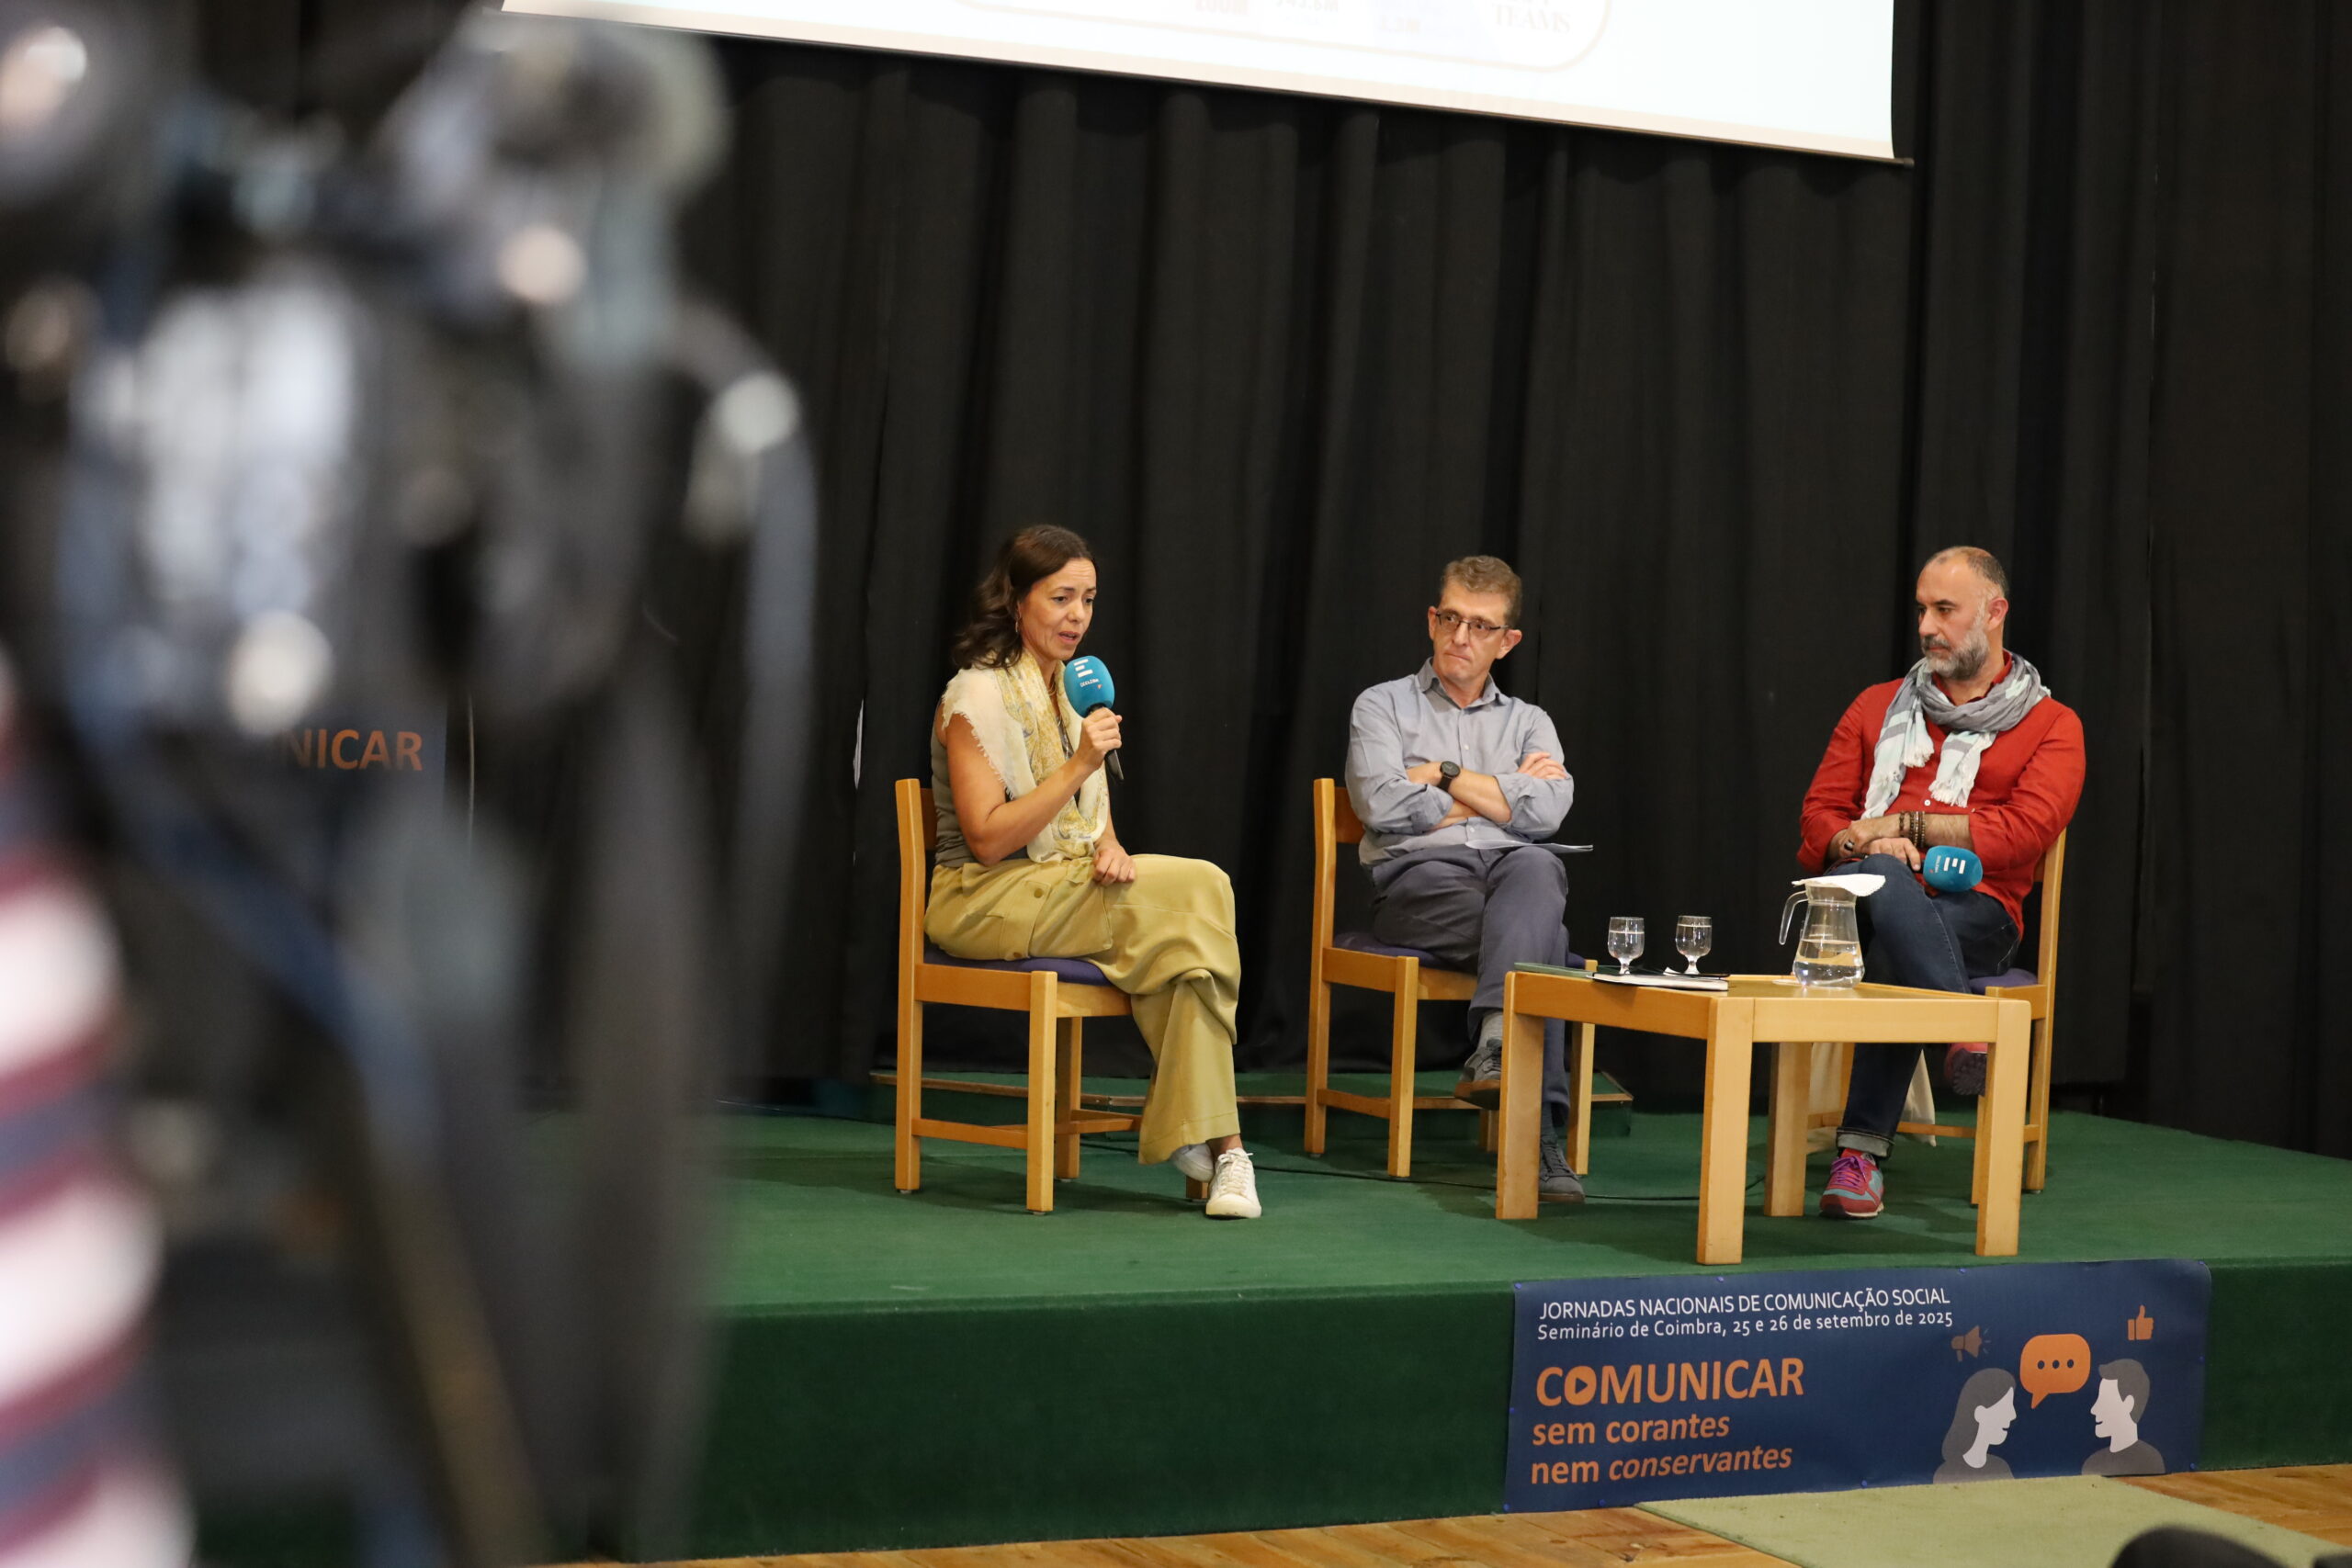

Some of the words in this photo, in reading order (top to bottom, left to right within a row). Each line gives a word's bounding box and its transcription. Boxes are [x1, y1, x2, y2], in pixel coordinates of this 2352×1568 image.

[1539, 1299, 1635, 1320] JORNADAS
[1640, 1295, 1735, 1316] NACIONAIS
[1738, 1294, 1761, 1314] DE
[1763, 1287, 1889, 1313] COMUNICAÇÃO
[1892, 1288, 1951, 1306] SOCIAL
[1537, 1321, 1624, 1340] Seminário
[1629, 1320, 1649, 1338] de
[1654, 1318, 1727, 1337] Coimbra,
[1733, 1320, 1750, 1337] 25
[1755, 1320, 1764, 1332] e
[1770, 1315, 1788, 1331] 26
[1792, 1314, 1811, 1330] de
[1816, 1311, 1890, 1329] setembro
[1894, 1309, 1913, 1325] de
[1918, 1312, 1952, 1327] 2025
[1536, 1357, 1804, 1406] COMUNICAR
[1532, 1421, 1596, 1446] sem
[1605, 1413, 1730, 1443] corantes
[1531, 1460, 1600, 1484] nem
[1609, 1445, 1792, 1481] conservantes
